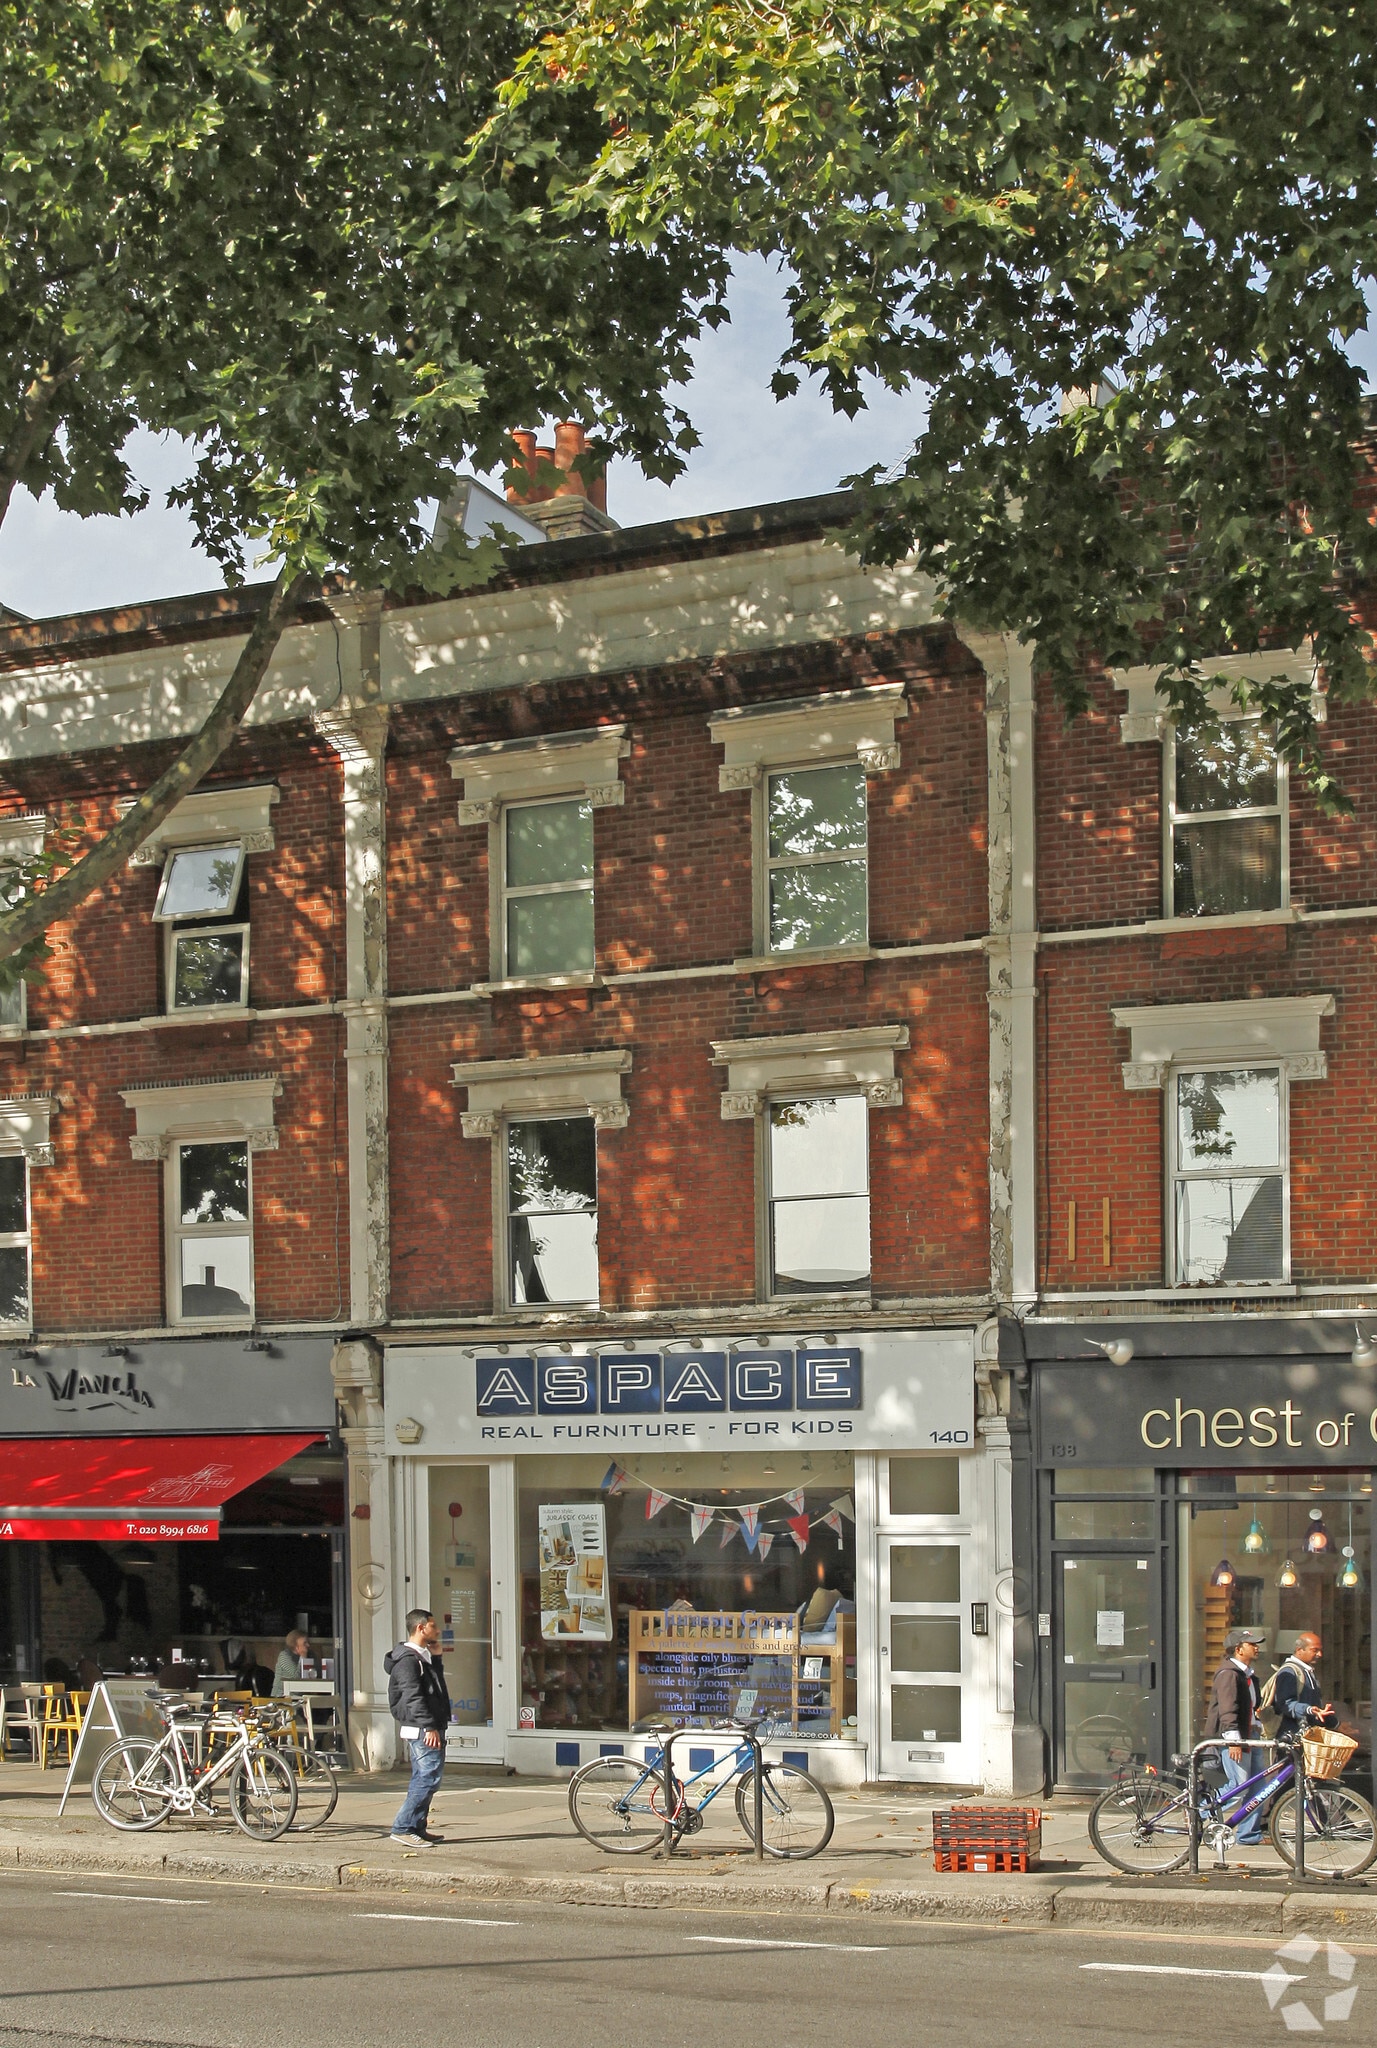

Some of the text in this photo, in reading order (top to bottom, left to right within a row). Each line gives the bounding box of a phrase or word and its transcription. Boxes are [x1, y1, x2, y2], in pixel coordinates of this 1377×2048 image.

[478, 1357, 852, 1406] ASPACE
[481, 1425, 544, 1439] REAL
[553, 1423, 697, 1438] FURNITURE
[728, 1421, 780, 1436] FOR
[791, 1419, 854, 1434] KIDS
[1140, 1397, 1302, 1449] chest
[1315, 1412, 1356, 1447] of
[928, 1430, 969, 1444] 140
[1050, 1443, 1077, 1457] 138
[127, 1523, 209, 1537] T: 020 8994 6816
[659, 1608, 797, 1632] Jurassic Coast
[659, 1639, 691, 1652] palette
[740, 1640, 760, 1650] reds
[762, 1640, 781, 1651] and
[655, 1651, 699, 1664] alongside
[701, 1651, 720, 1665] oily
[721, 1651, 747, 1662] blues
[639, 1663, 697, 1675] spectacular,
[648, 1675, 676, 1686] inside
[677, 1676, 702, 1687] their
[703, 1679, 733, 1690] room,
[654, 1691, 683, 1702] maps,
[659, 1701, 696, 1712] nautical
[699, 1702, 731, 1713] motifs
